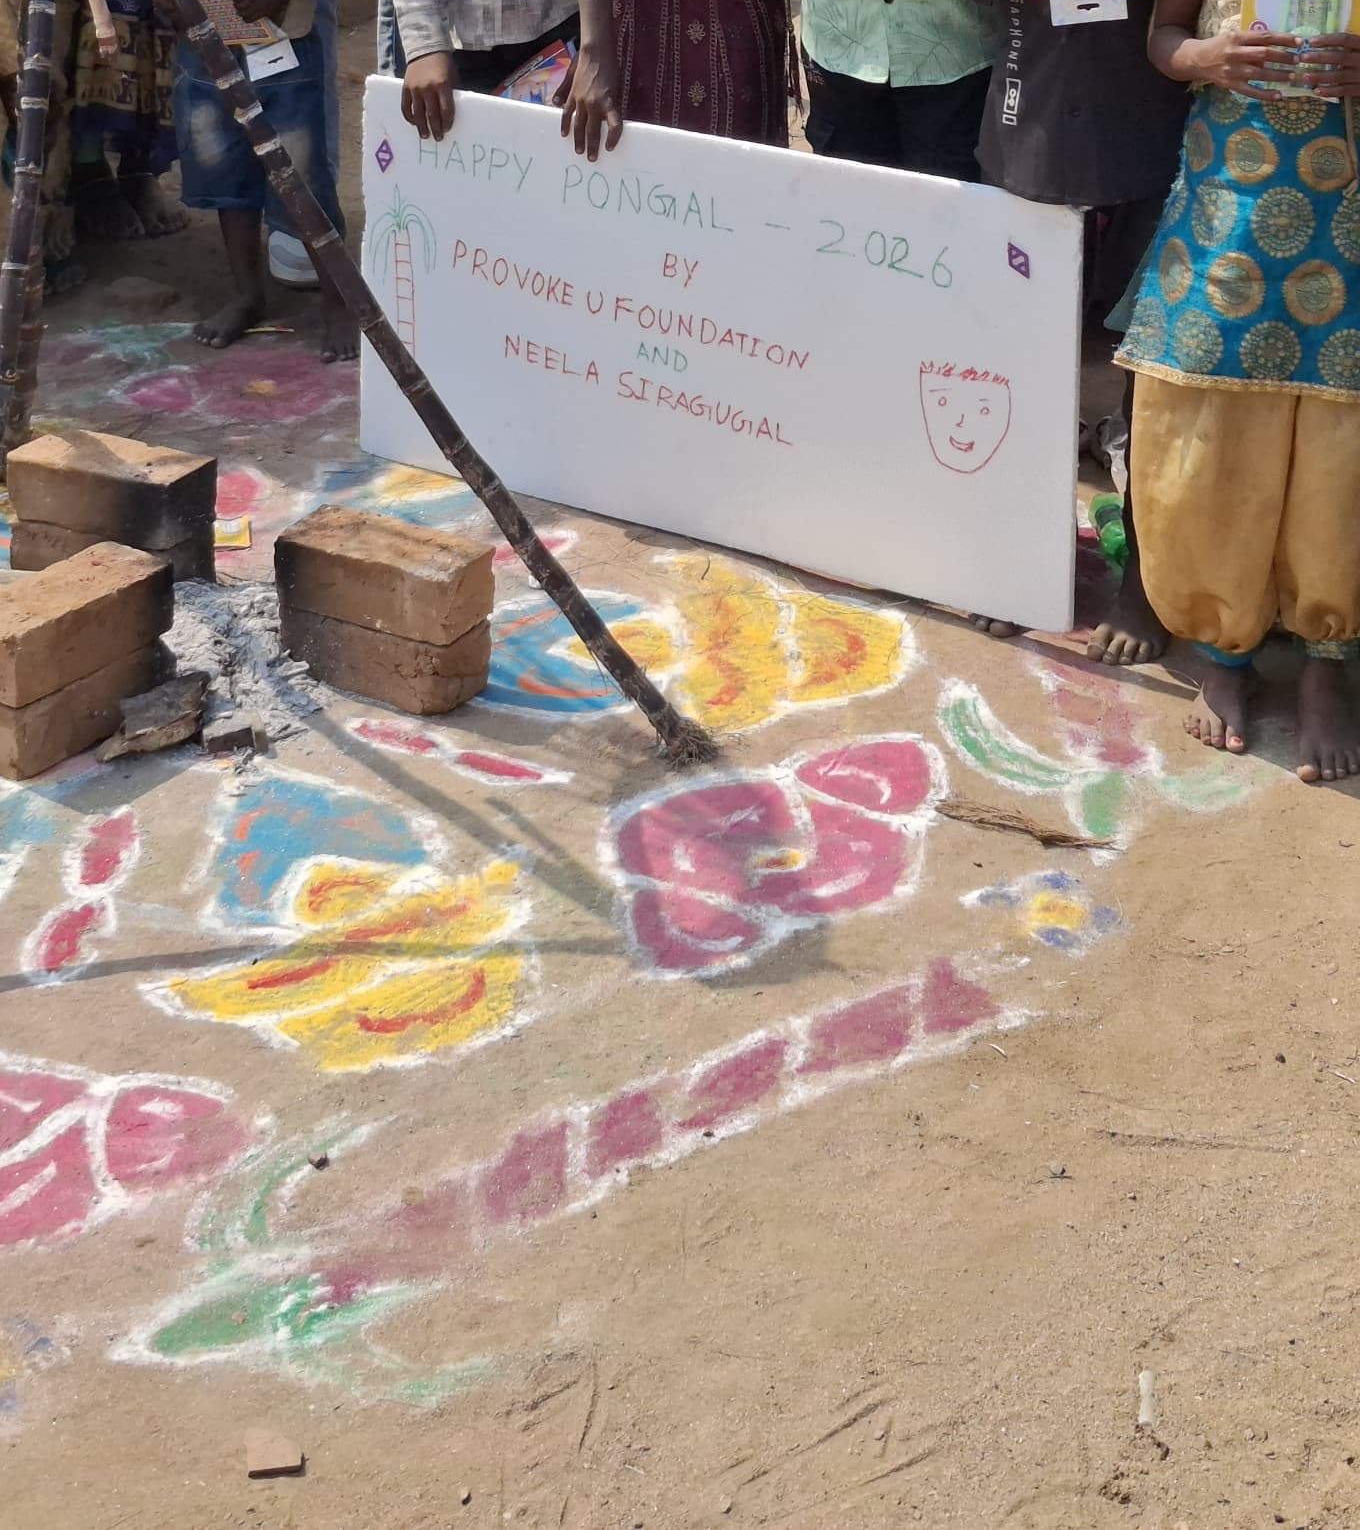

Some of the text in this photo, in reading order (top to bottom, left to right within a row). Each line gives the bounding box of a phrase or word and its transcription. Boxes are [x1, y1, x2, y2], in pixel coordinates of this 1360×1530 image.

[418, 137, 533, 192] HAPPY
[562, 164, 734, 232] PONGAL
[815, 219, 953, 288] 2026
[452, 239, 809, 370] PROVOKE U FOUNDATION
[662, 252, 698, 288] BY
[504, 333, 793, 447] NEELA SIRAGUGAL
[636, 341, 688, 373] AND
